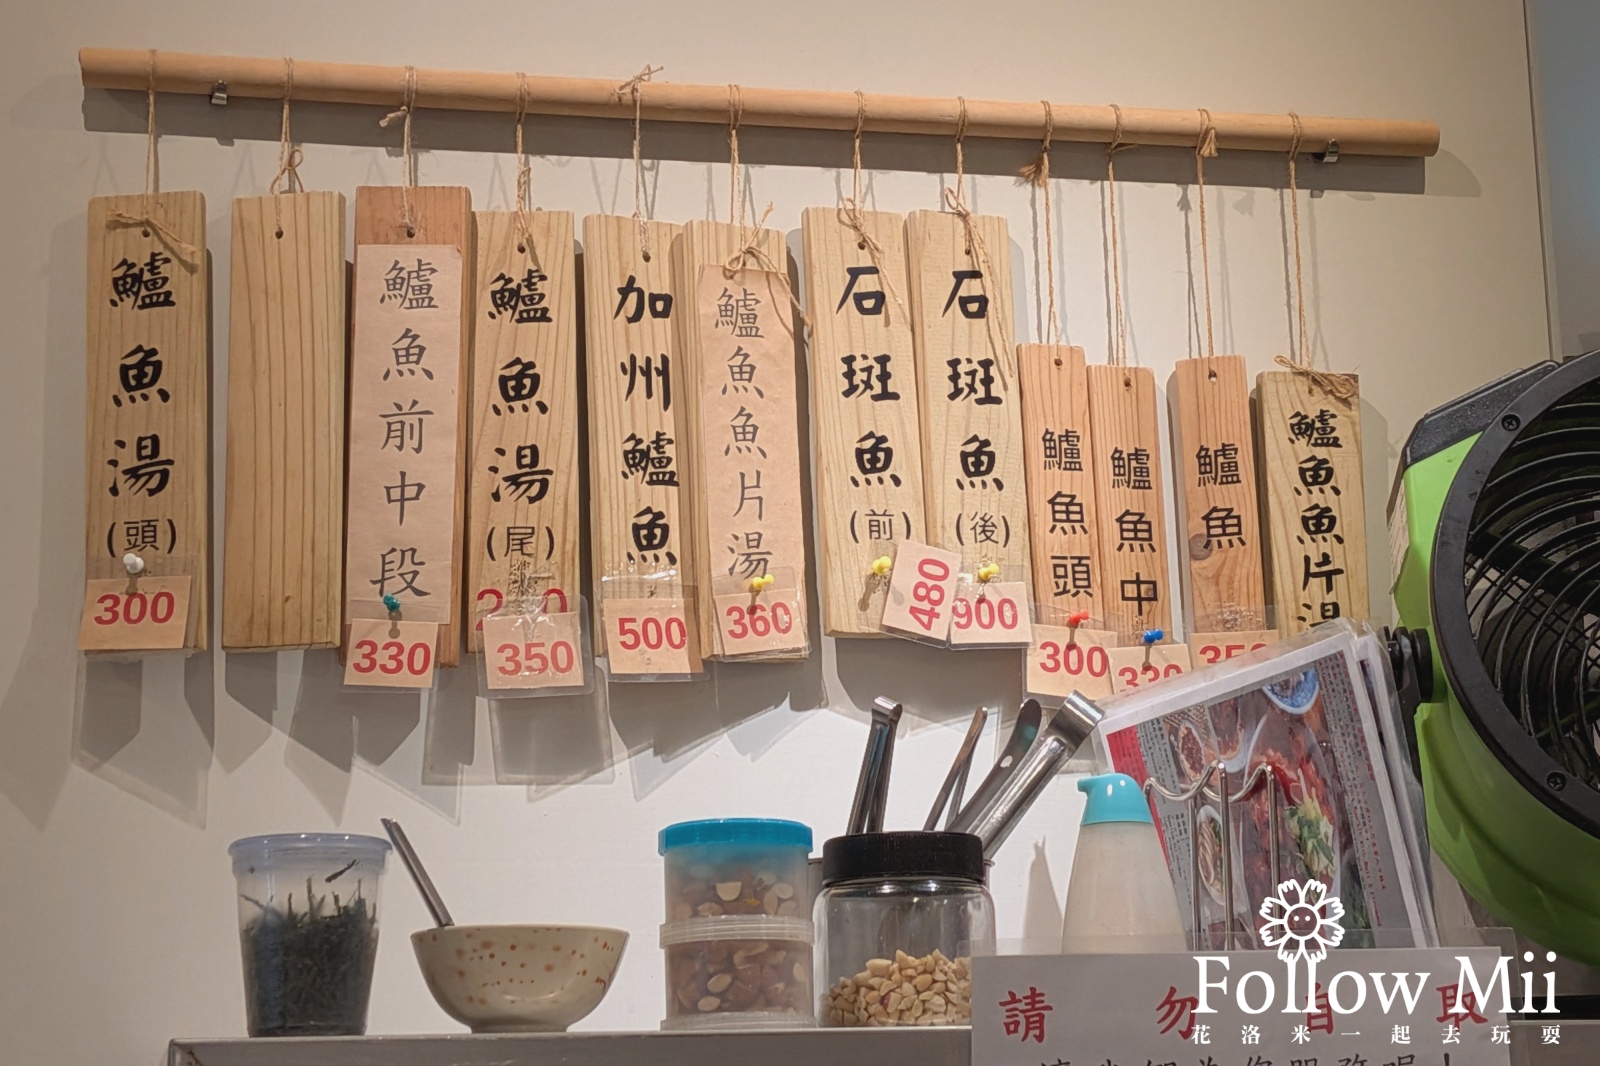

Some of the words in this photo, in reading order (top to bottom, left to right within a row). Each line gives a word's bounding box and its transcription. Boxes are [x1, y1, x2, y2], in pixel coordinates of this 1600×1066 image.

[107, 252, 177, 498] 鱸魚湯
[370, 258, 440, 599] 鱸魚前中段
[487, 269, 554, 505] 鱸魚湯
[614, 275, 679, 566] 加州鱸魚
[714, 287, 775, 580] 鱸魚魚片湯
[836, 266, 902, 488] 石斑魚
[942, 270, 1004, 491] 石斑魚
[1041, 427, 1094, 599] 鱸魚頭
[1110, 446, 1158, 617] 鱸魚中
[1195, 442, 1247, 550] 鱸魚
[93, 591, 176, 626] 300
[352, 640, 431, 677] 330
[496, 640, 574, 676] 350
[618, 617, 686, 651] 500
[725, 601, 793, 640] 360
[909, 558, 951, 631] 480
[952, 598, 1018, 630] 900
[1039, 641, 1108, 677] 300
